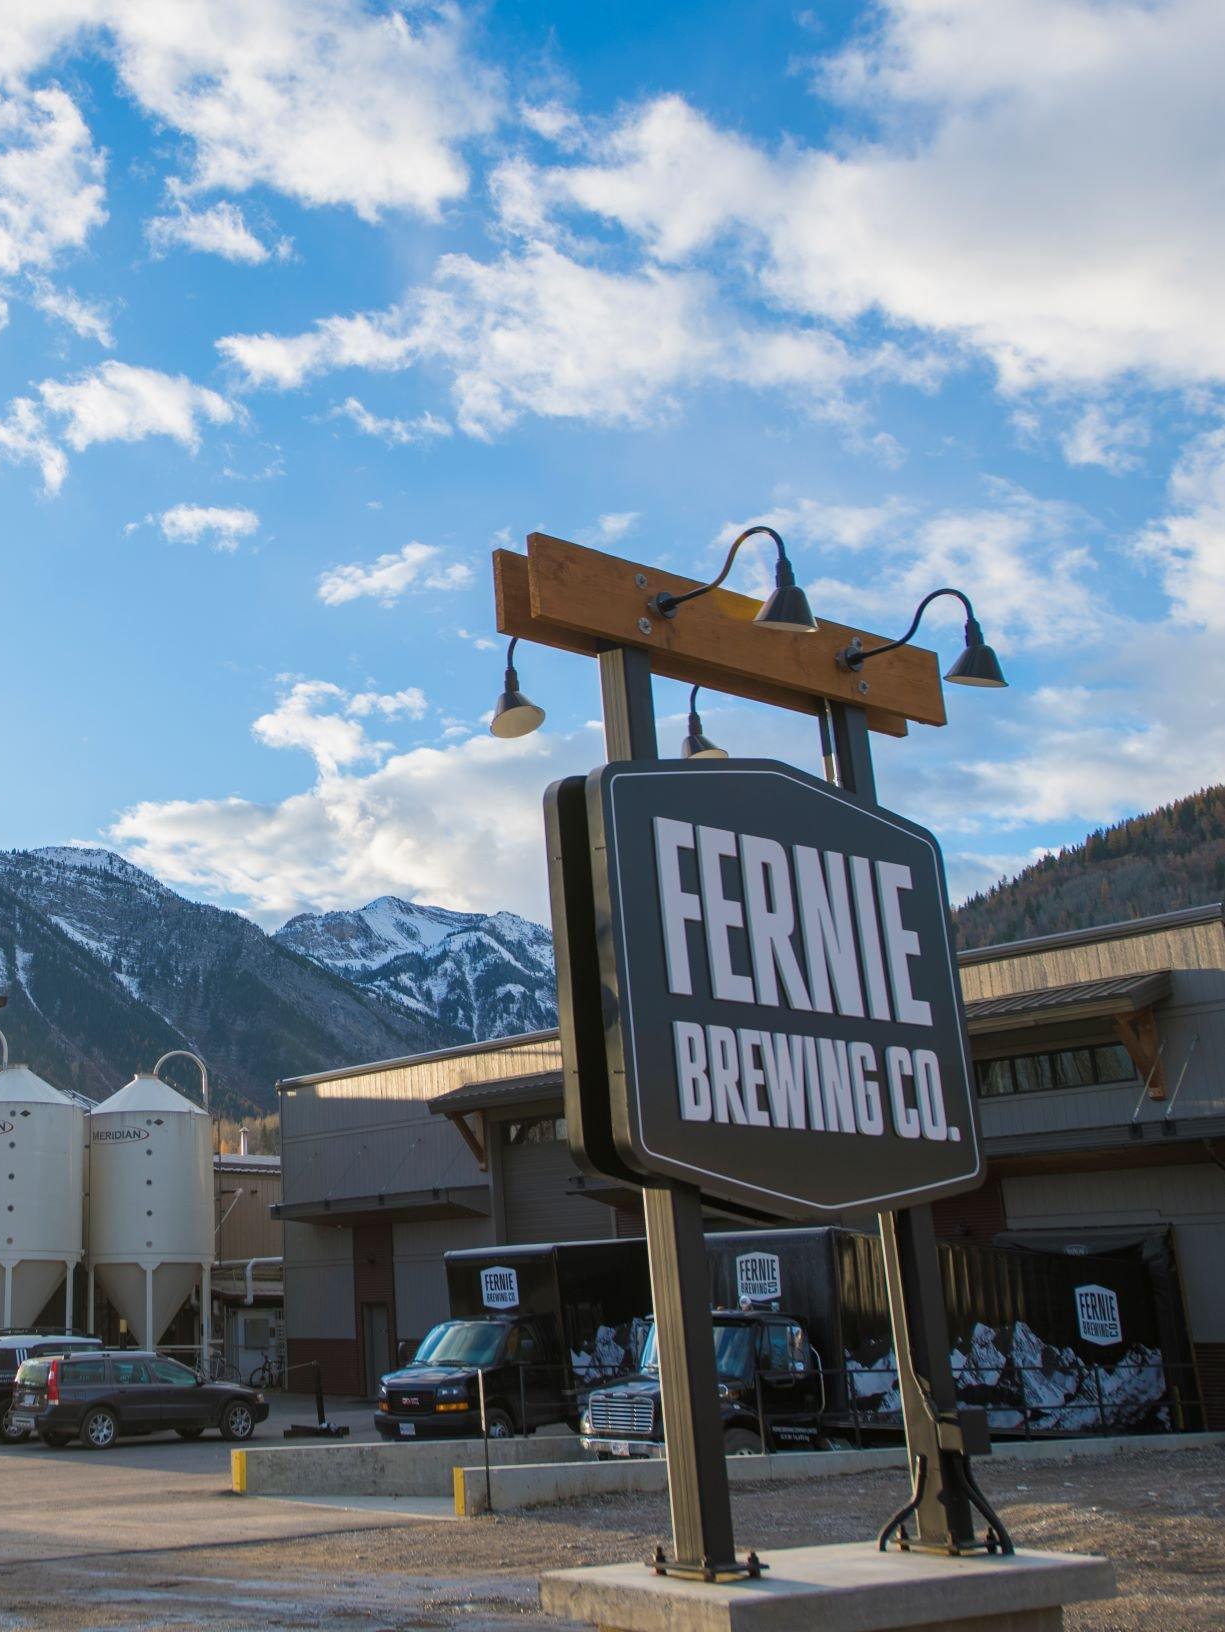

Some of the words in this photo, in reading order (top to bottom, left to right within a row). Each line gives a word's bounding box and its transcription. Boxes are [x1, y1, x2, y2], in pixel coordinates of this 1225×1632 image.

[653, 816, 933, 1026] FERNIE
[672, 1020, 884, 1136] BREWING
[885, 1046, 961, 1142] CO.
[92, 1130, 141, 1141] MERIDIAN
[739, 1258, 777, 1281] FERNIE
[484, 1273, 514, 1291] FERNIE
[741, 1282, 767, 1295] BREWING
[767, 1282, 778, 1294] CO
[486, 1292, 508, 1303] BREWING
[1079, 1292, 1116, 1321] FERNIE
[1082, 1321, 1109, 1338] BREWING
[1109, 1323, 1119, 1337] CO
